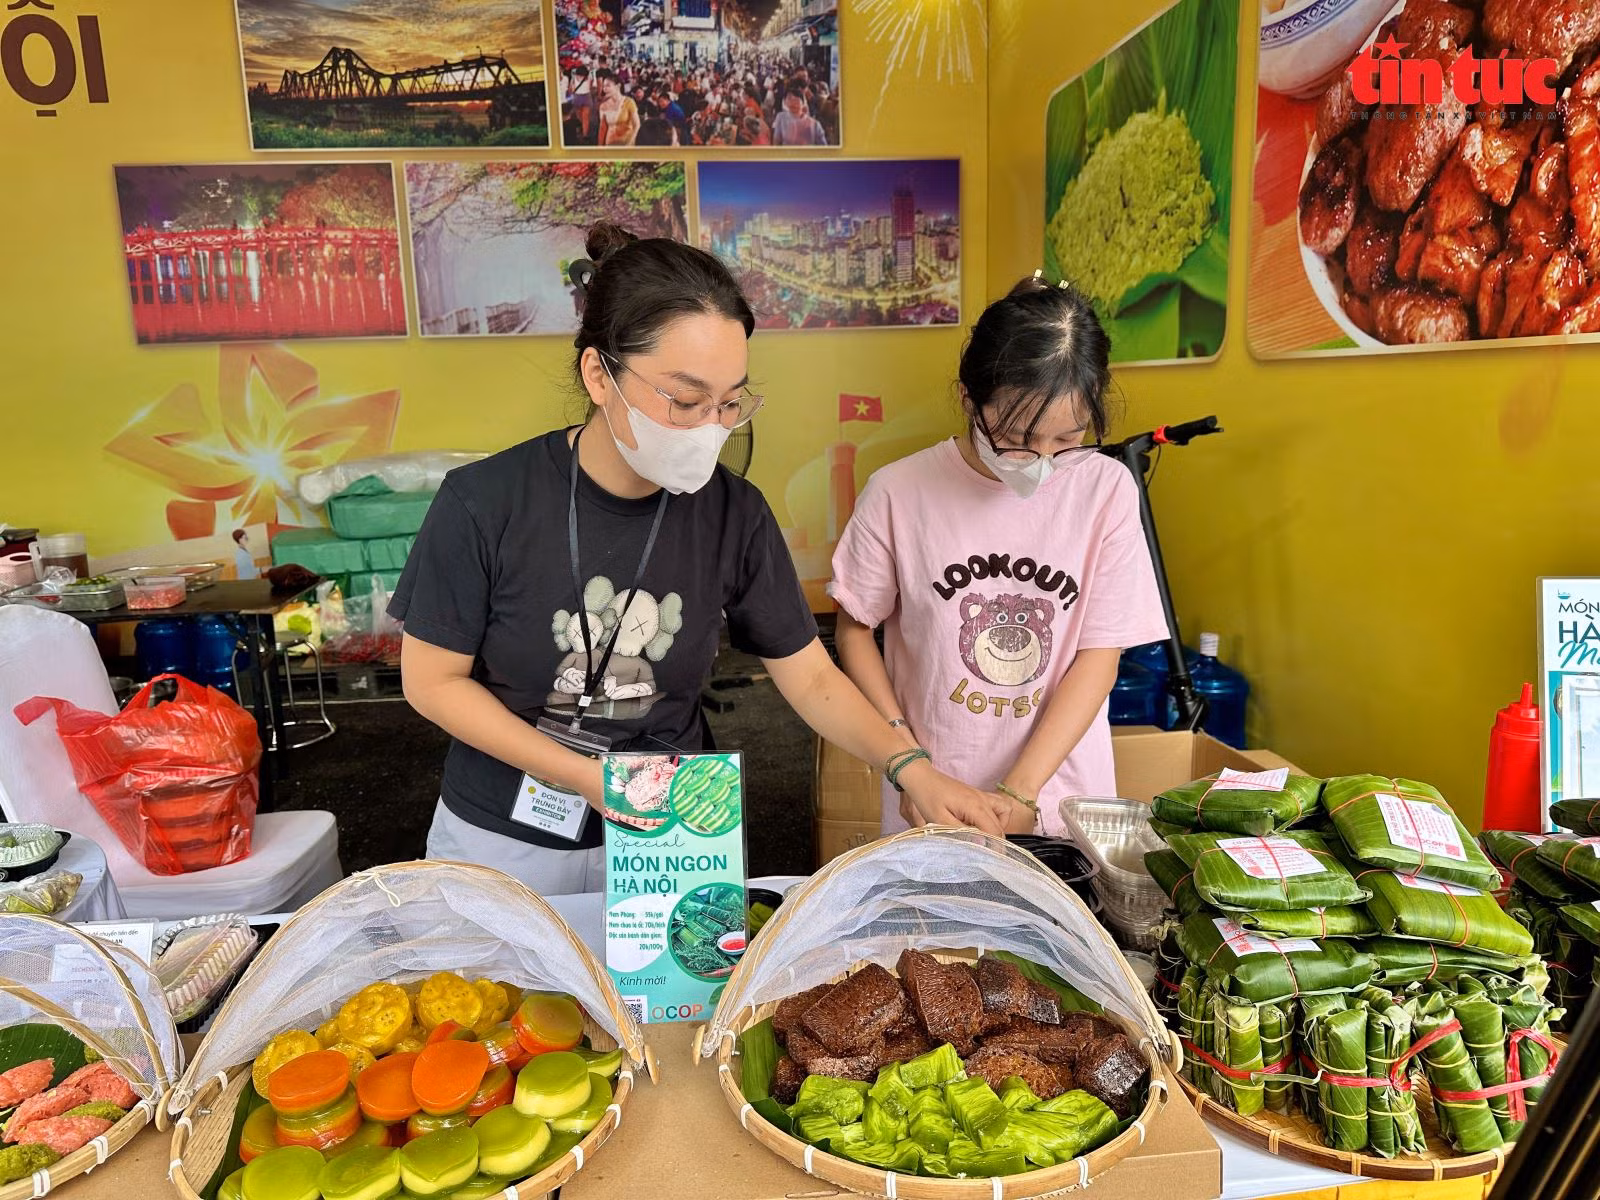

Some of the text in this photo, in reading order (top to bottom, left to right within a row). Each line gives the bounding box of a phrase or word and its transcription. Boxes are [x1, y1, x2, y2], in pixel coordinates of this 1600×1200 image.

[932, 553, 1080, 611] LOOKOUT!
[1558, 598, 1600, 613] MÓN
[1558, 614, 1600, 643] HÀ
[614, 830, 685, 853] Special
[613, 853, 727, 872] MÓN NGON
[614, 874, 677, 898] HÀ NỘI
[651, 1003, 703, 1020] OCOP
